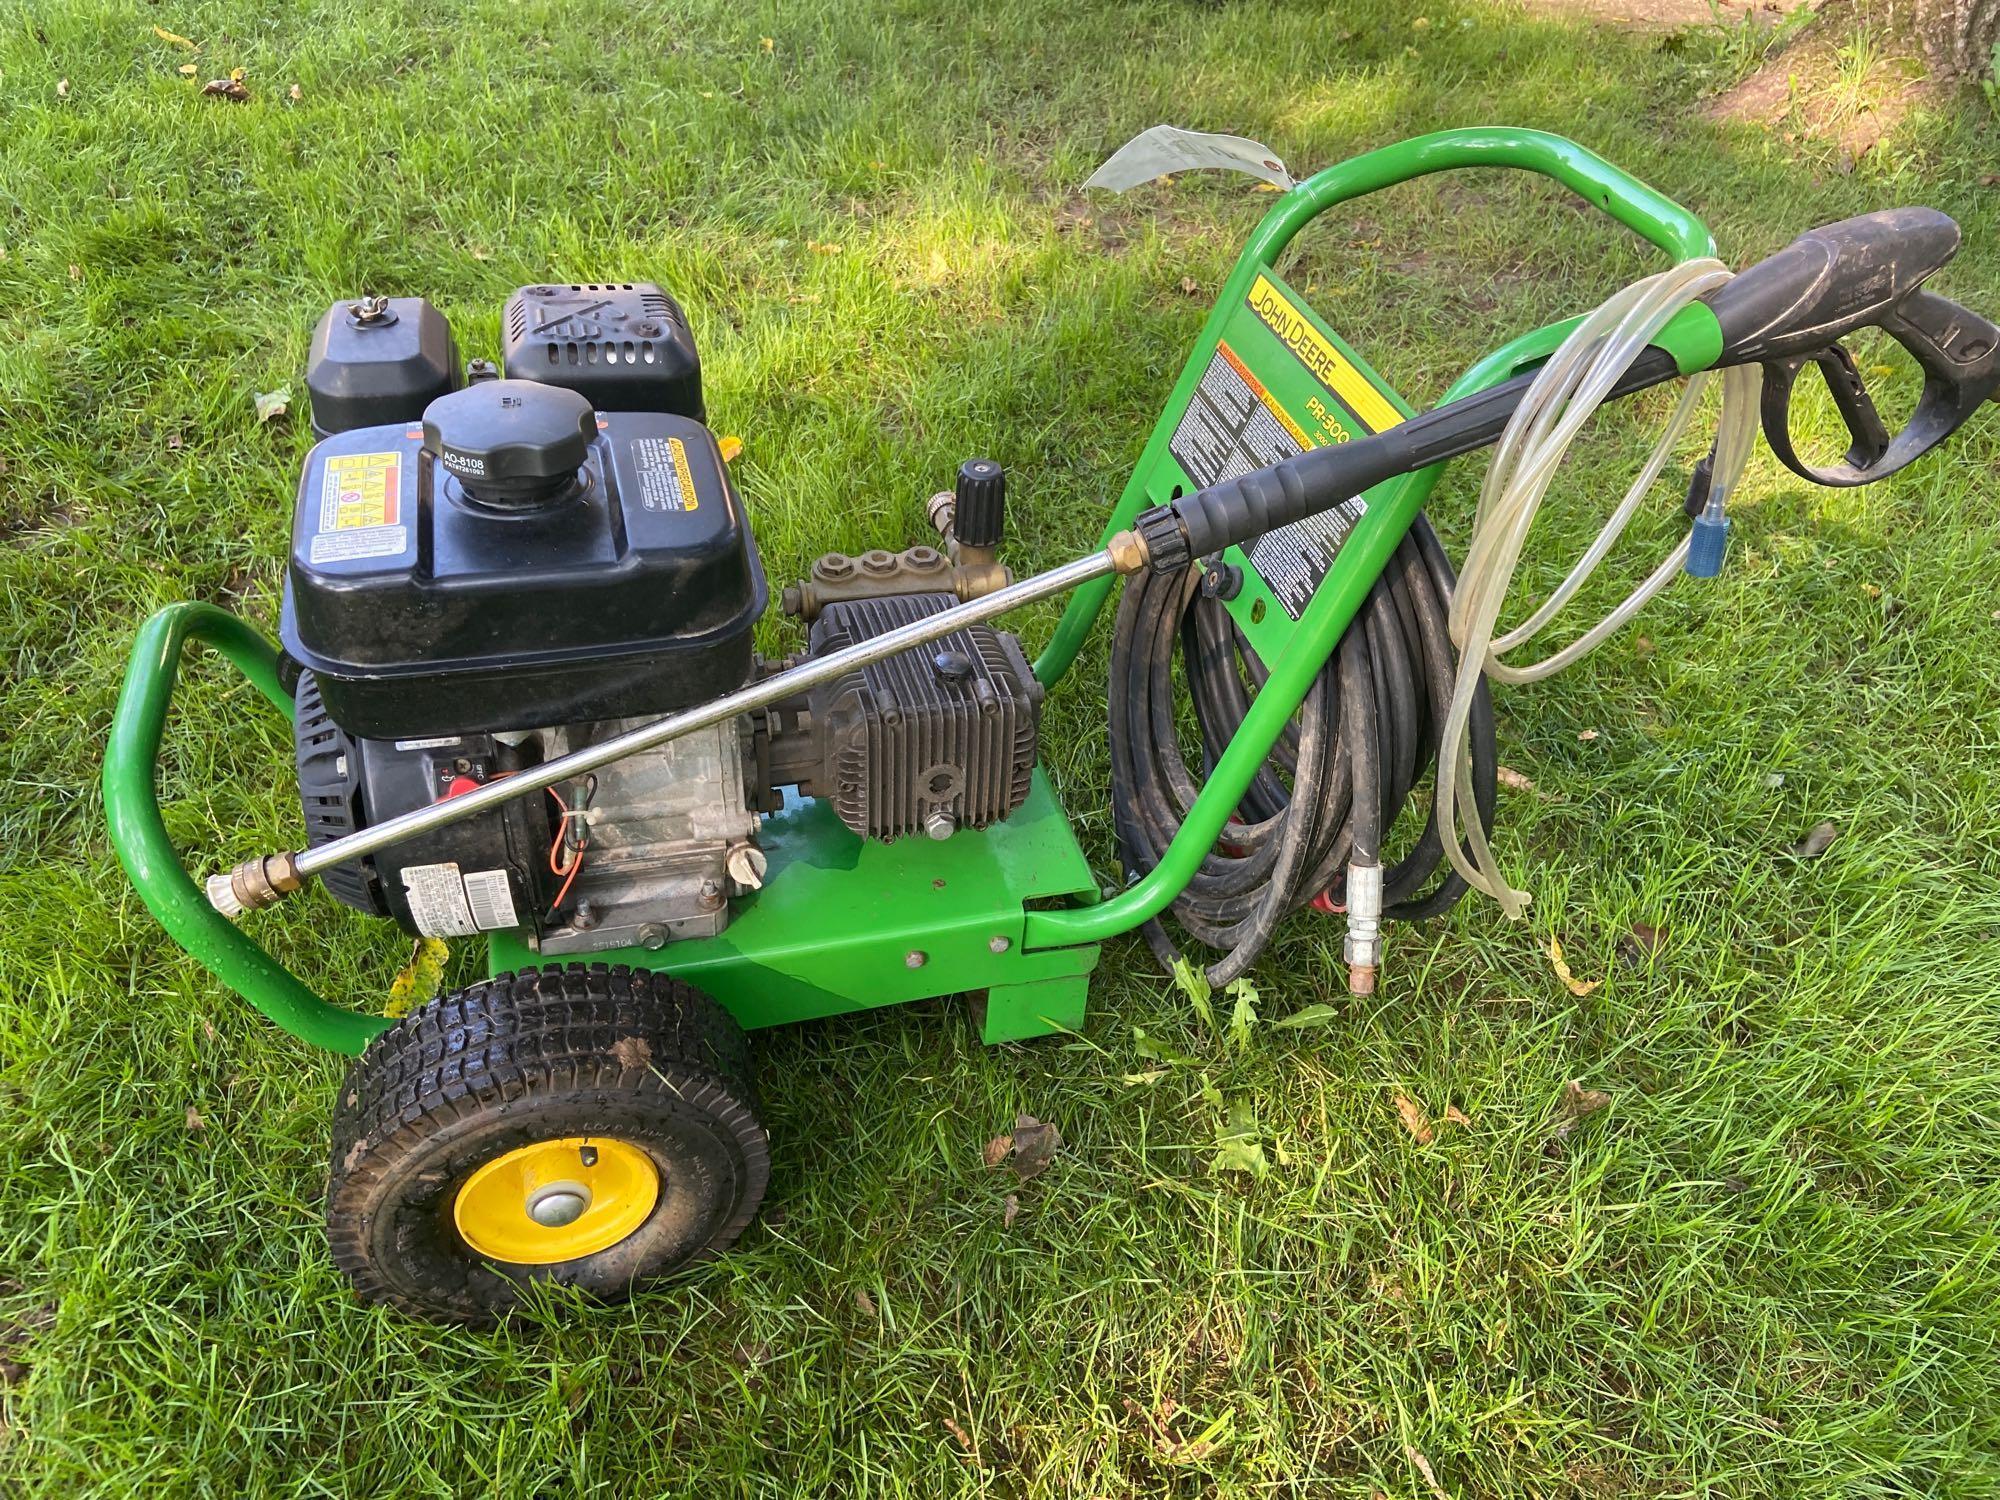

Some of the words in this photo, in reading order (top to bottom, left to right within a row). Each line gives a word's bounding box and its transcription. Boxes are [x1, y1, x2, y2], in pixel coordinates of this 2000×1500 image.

[1253, 289, 1292, 335] JOHN
[1287, 320, 1336, 381] DEERE
[444, 451, 485, 470] AO-8108
